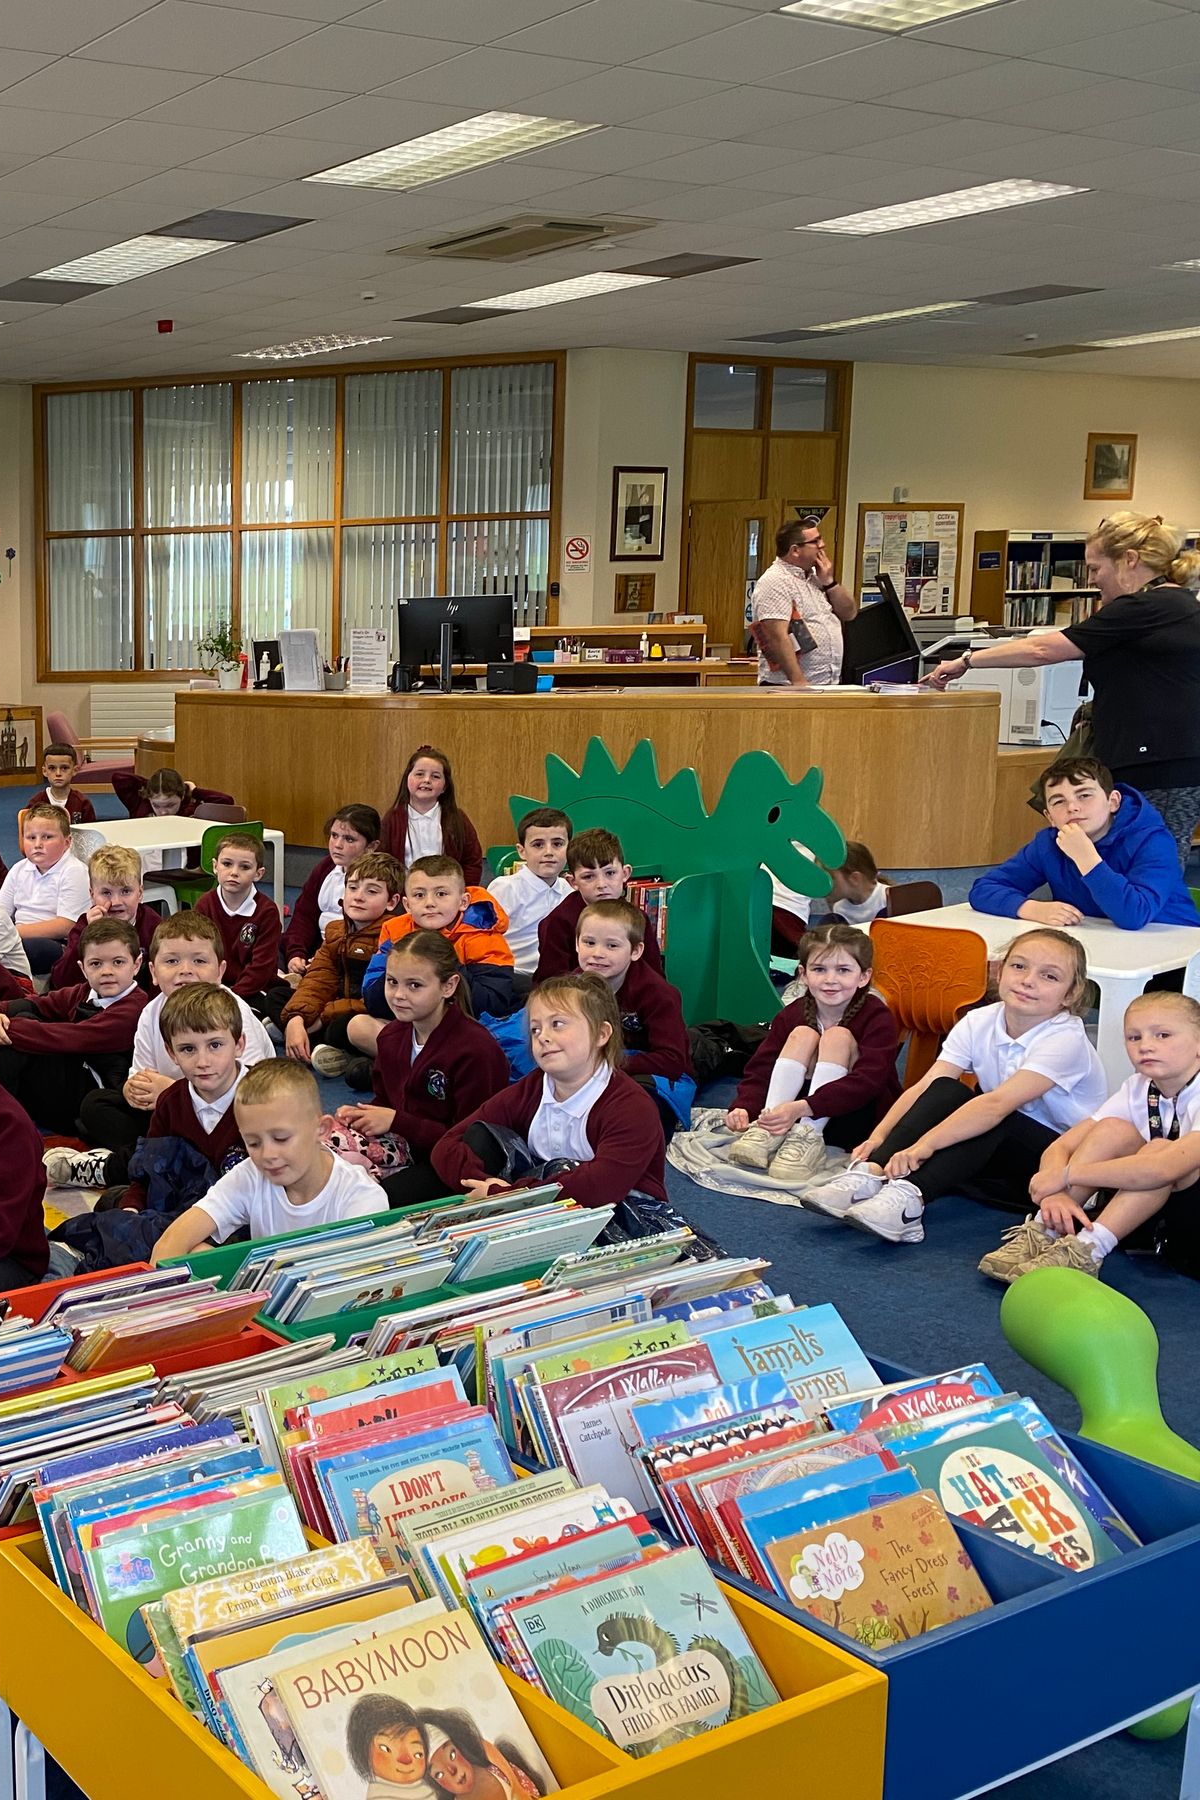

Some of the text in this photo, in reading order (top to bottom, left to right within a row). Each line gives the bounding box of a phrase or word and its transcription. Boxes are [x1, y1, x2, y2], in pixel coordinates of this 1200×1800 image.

[446, 600, 459, 616] hp
[731, 1324, 825, 1377] Jamal's
[790, 1370, 849, 1400] urney
[579, 1428, 613, 1443] Catchpole
[581, 1417, 603, 1431] James
[960, 1453, 981, 1468] THE
[389, 1484, 401, 1506] I
[398, 1470, 446, 1503] DON'T
[947, 1463, 1014, 1509] HAT
[1007, 1471, 1039, 1490] THAT
[158, 1532, 253, 1568] Granny and
[813, 1541, 850, 1569] Nelly
[887, 1539, 914, 1560] The
[136, 1559, 153, 1579] Pig
[243, 1565, 312, 1592] Quentin Blake
[822, 1567, 856, 1593] Nora
[880, 1553, 949, 1586] Fancy Dress
[226, 1573, 339, 1614] Emma Chichester Clark
[586, 1586, 629, 1614] DINOSAUR'S
[630, 1584, 647, 1598] DAY
[901, 1578, 939, 1602] Forest
[293, 1621, 471, 1709] BABYMOON
[204, 1688, 217, 1716] DINO
[621, 1685, 721, 1736] FINDS ITS FAMILY
